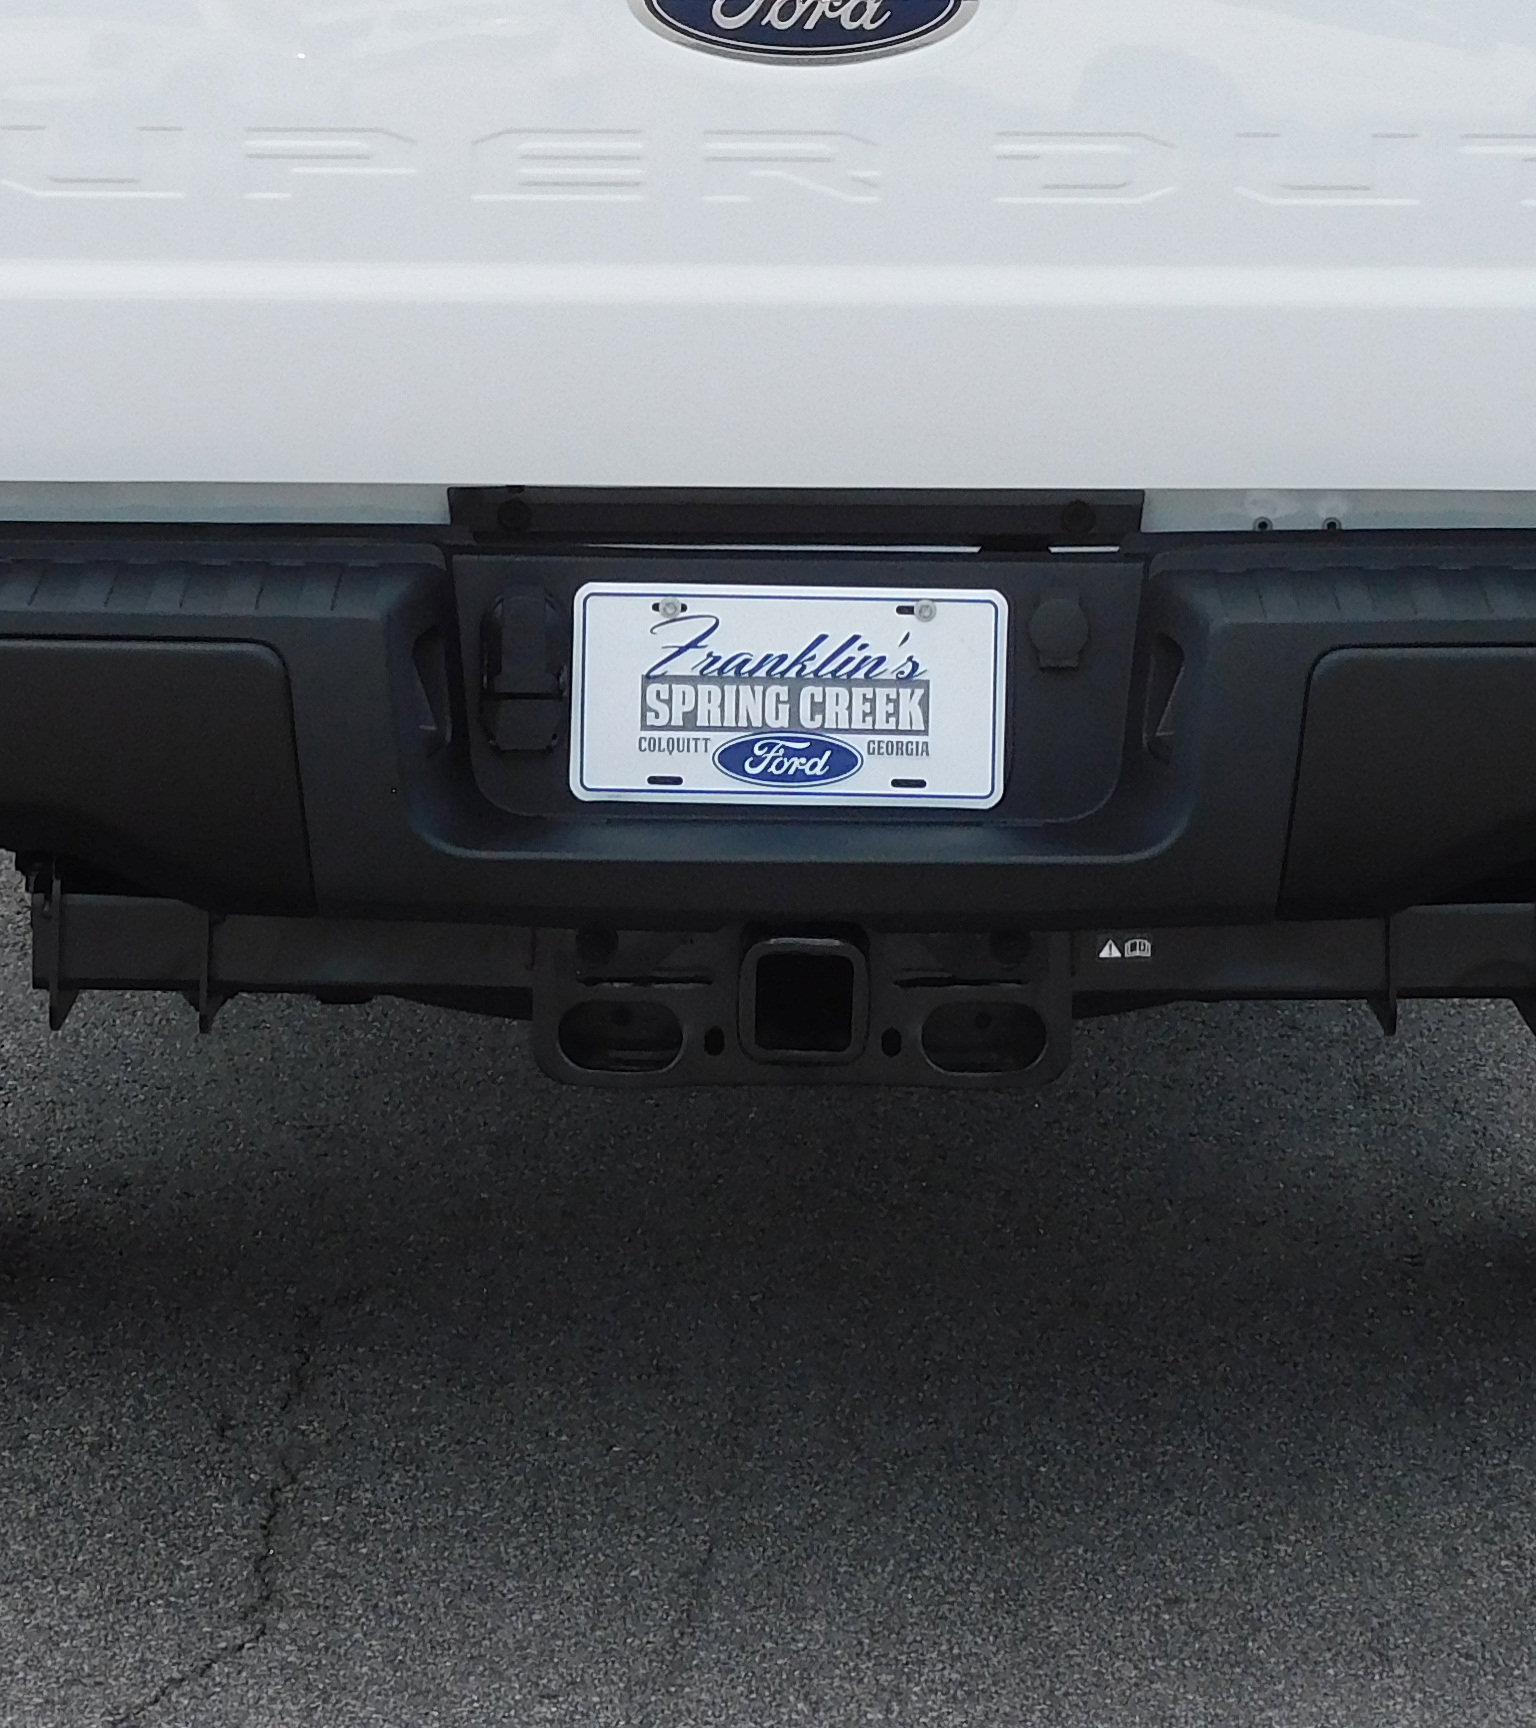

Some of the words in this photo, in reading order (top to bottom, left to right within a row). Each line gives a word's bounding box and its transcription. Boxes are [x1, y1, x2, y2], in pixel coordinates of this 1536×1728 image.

[645, 614, 927, 680] Franklin's
[645, 683, 790, 729] SPRING
[799, 684, 926, 731] CREEK
[637, 736, 711, 755] COLQUITT
[744, 739, 831, 776] Ford
[866, 739, 930, 757] GEORGIA
